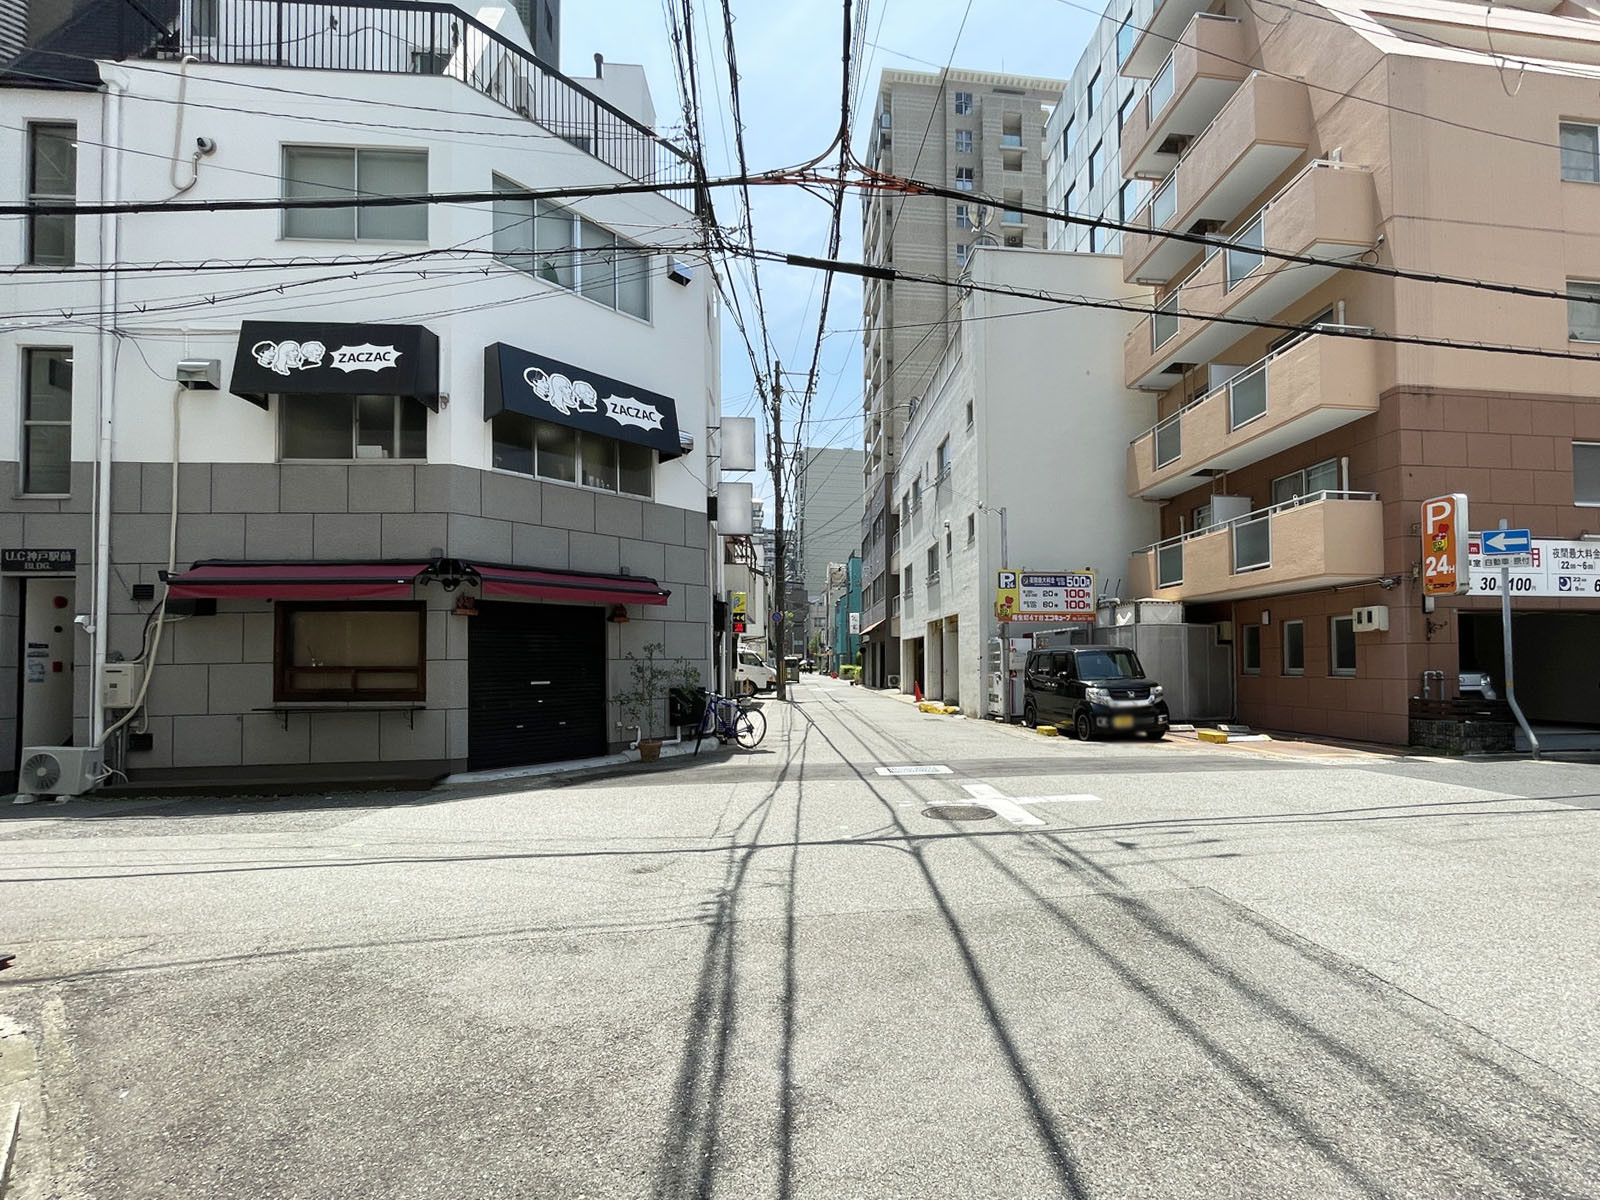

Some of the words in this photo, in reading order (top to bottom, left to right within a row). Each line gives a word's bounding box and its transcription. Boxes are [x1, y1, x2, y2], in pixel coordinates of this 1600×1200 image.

[338, 351, 392, 363] ZACZAC
[611, 402, 657, 423] ZACZAC
[1426, 501, 1452, 535] P
